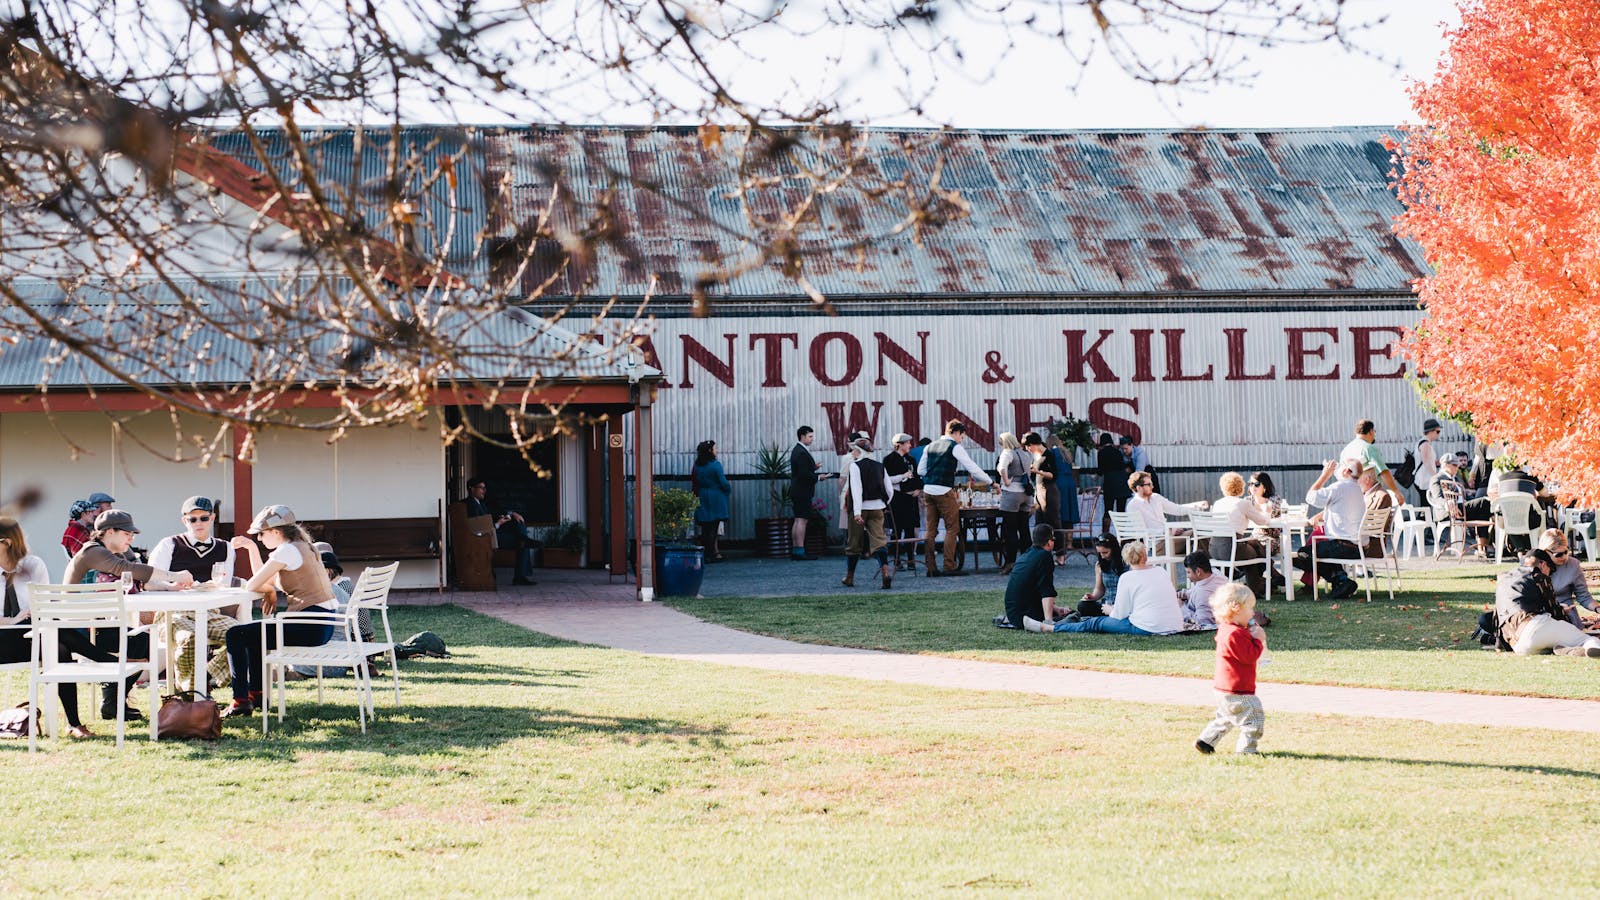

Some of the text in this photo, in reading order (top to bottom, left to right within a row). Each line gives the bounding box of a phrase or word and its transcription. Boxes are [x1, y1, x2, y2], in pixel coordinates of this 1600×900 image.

[578, 326, 1428, 389] ANTON & KILLEE
